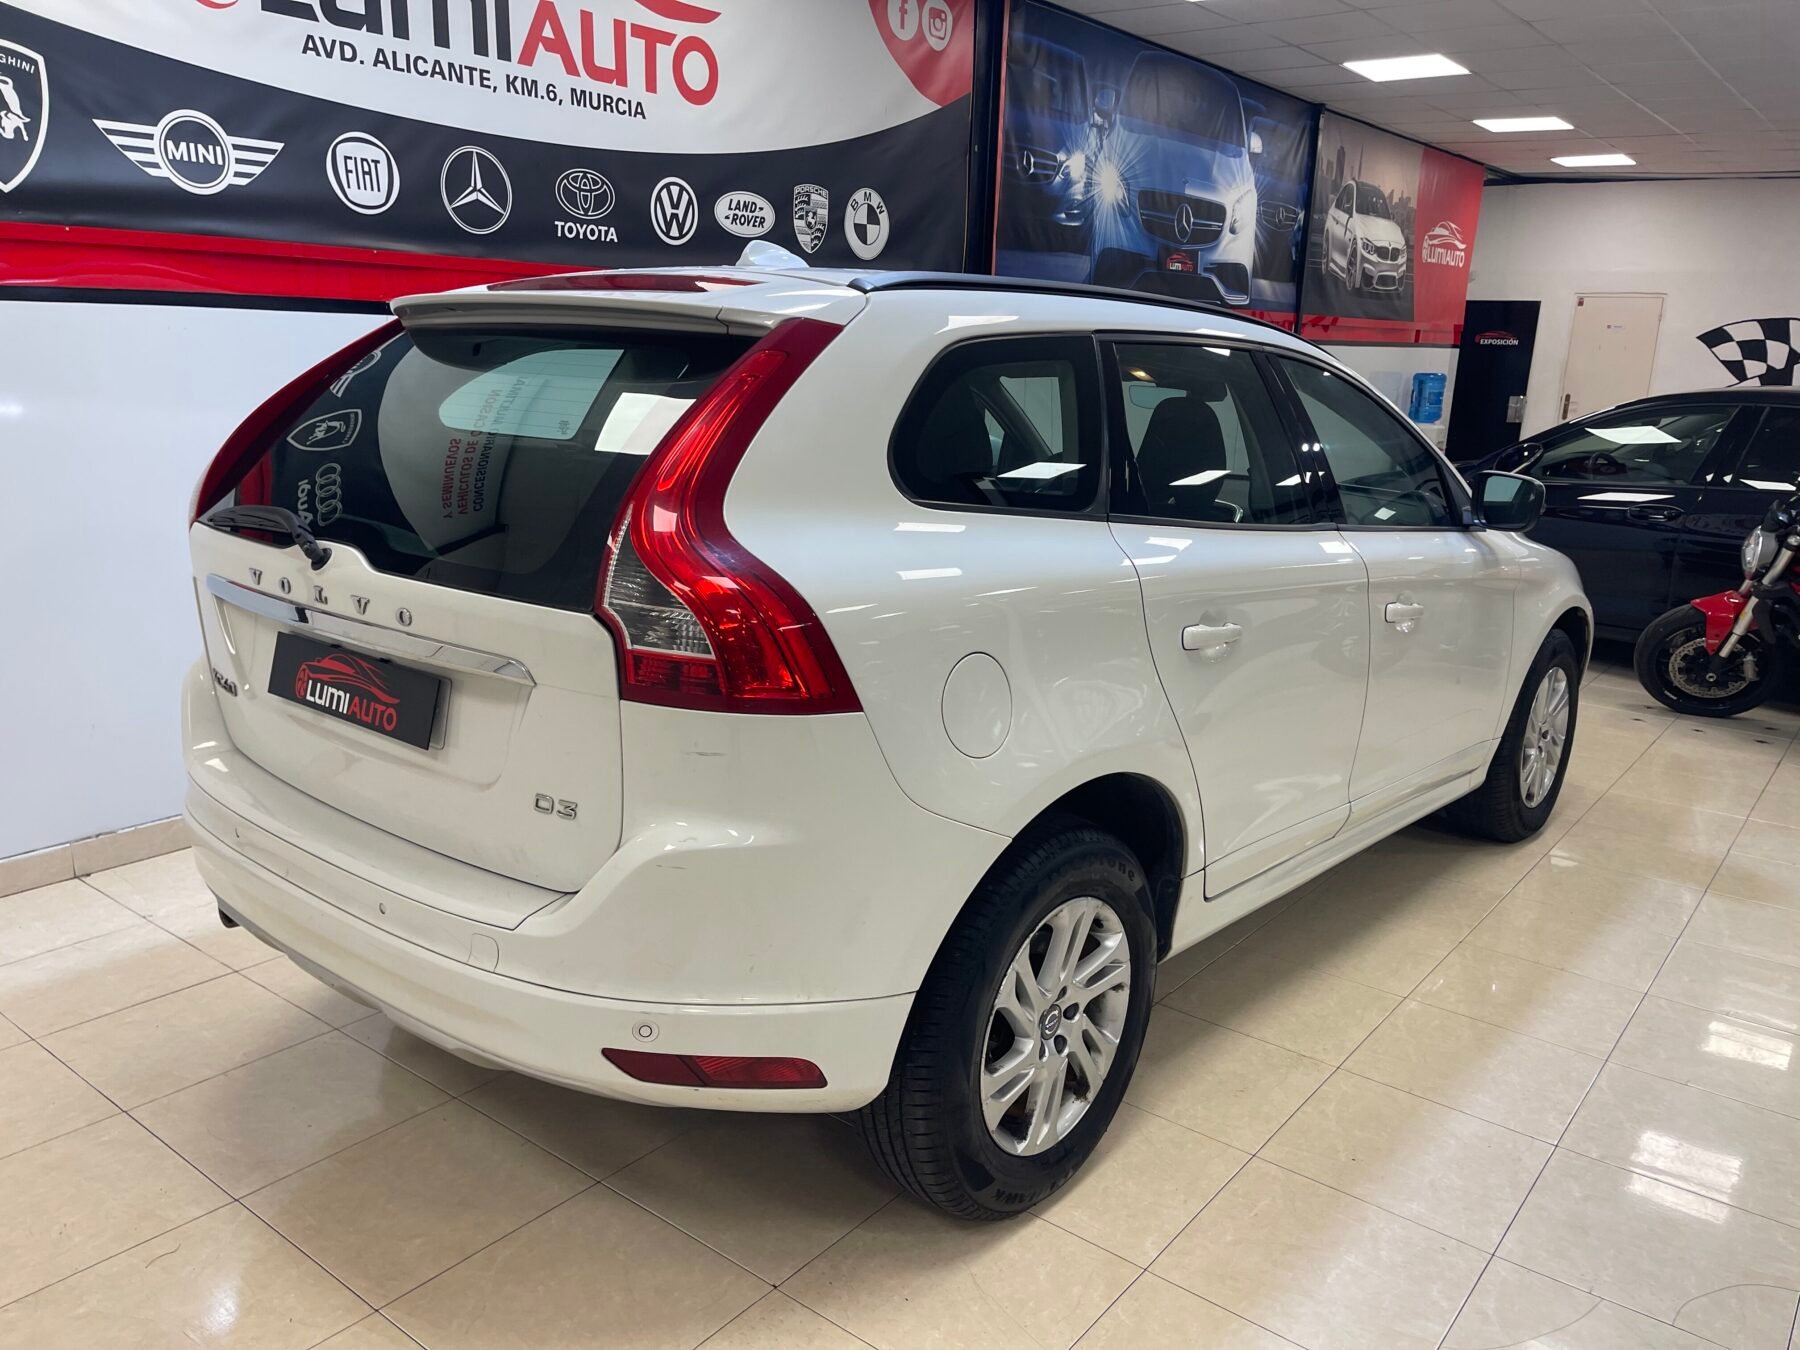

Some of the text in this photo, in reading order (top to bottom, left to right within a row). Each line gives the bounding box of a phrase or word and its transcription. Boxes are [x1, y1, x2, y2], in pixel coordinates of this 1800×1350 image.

[301, 34, 647, 120] AVD. ALICANTE, KM.6, MURCIA
[166, 139, 223, 166] MINI
[343, 155, 381, 194] FIAT
[728, 198, 757, 213] LAND
[794, 186, 828, 199] PORSCHE
[850, 191, 885, 216] BMW
[554, 220, 618, 243] TOYOTA
[730, 215, 766, 229] ROVER
[249, 567, 413, 627] VOLVO
[533, 793, 578, 821] D3
